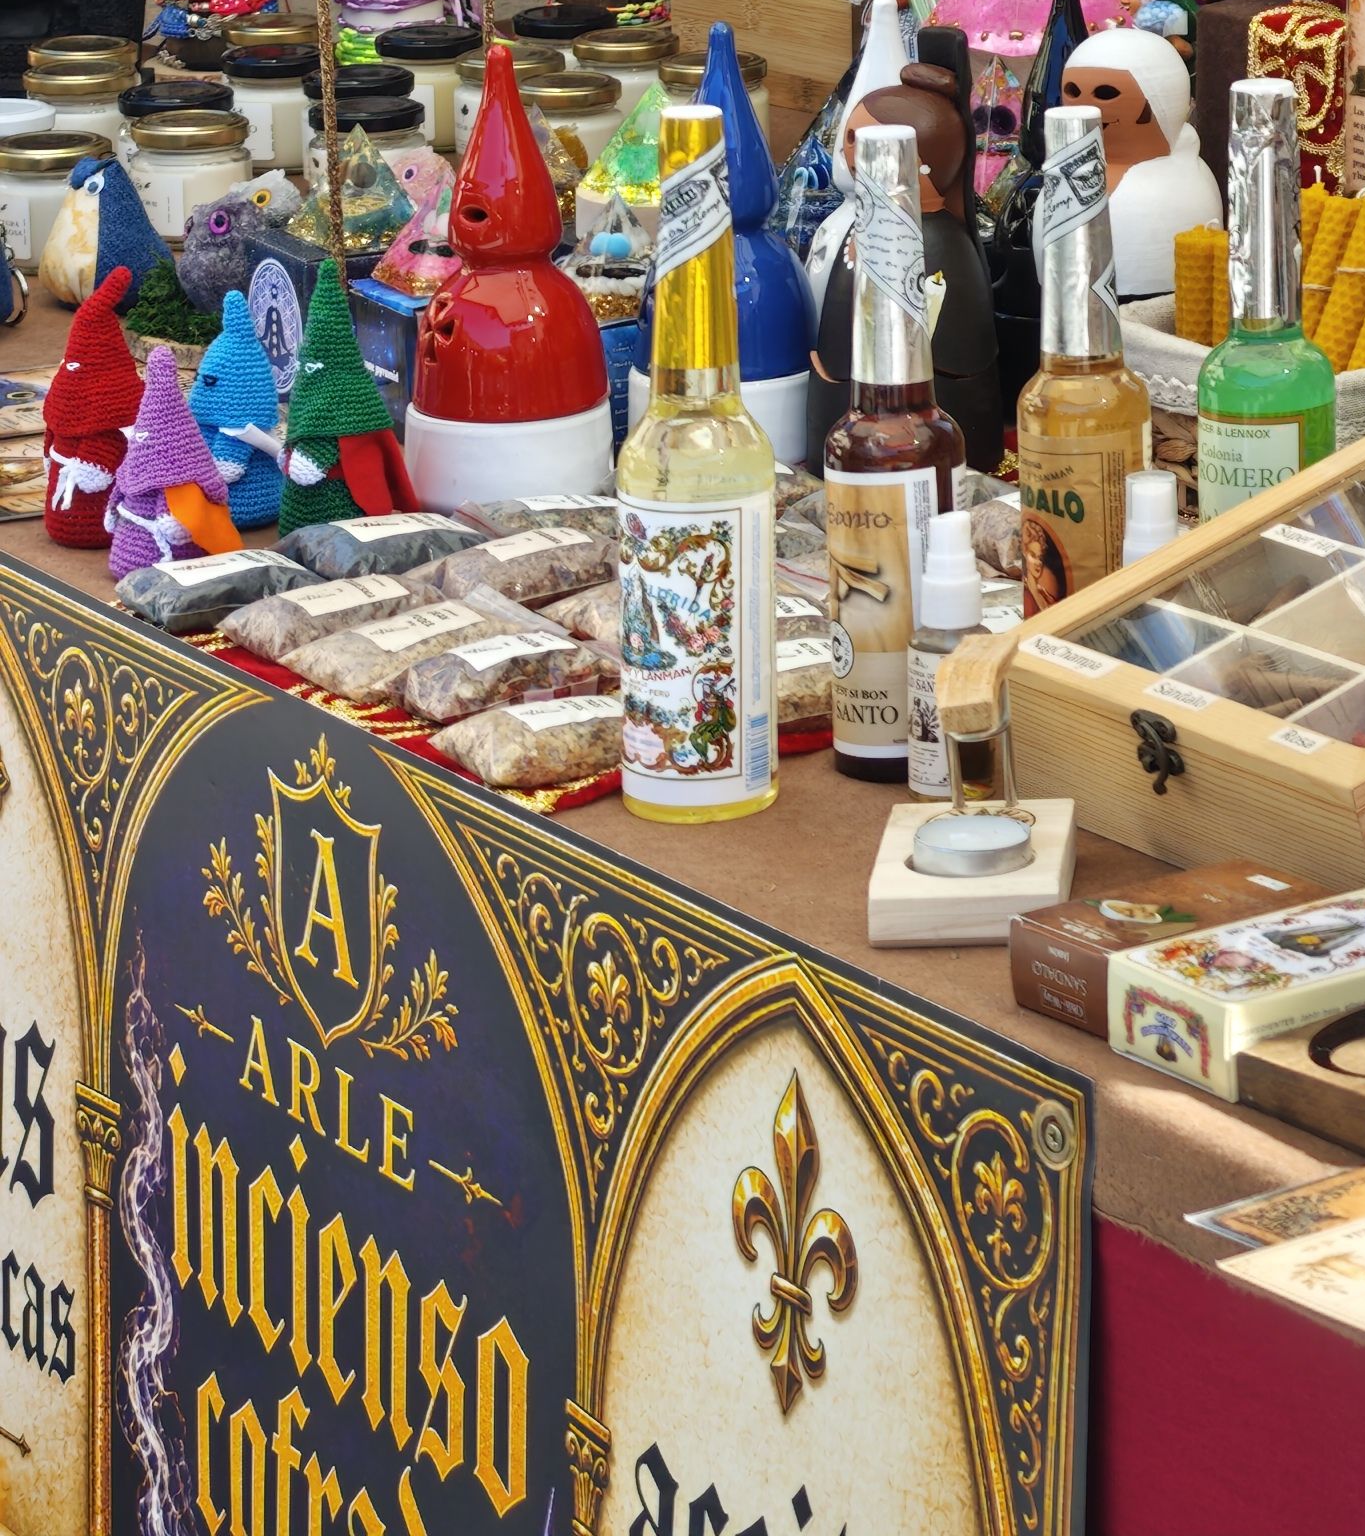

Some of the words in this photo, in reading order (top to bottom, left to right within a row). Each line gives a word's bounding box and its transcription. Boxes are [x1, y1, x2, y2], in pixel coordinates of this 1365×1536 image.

[1225, 428, 1270, 439] LENNOX
[1201, 443, 1243, 463] Colonia
[1199, 460, 1296, 488] ROMERO
[827, 501, 891, 529] Santo
[644, 583, 712, 622] LORIDA
[862, 689, 889, 700] BON
[836, 704, 899, 726] SANTO
[1282, 729, 1317, 749] Rosa
[294, 828, 360, 990] A
[239, 1015, 416, 1191] ARLE
[167, 1043, 529, 1518] incienso
